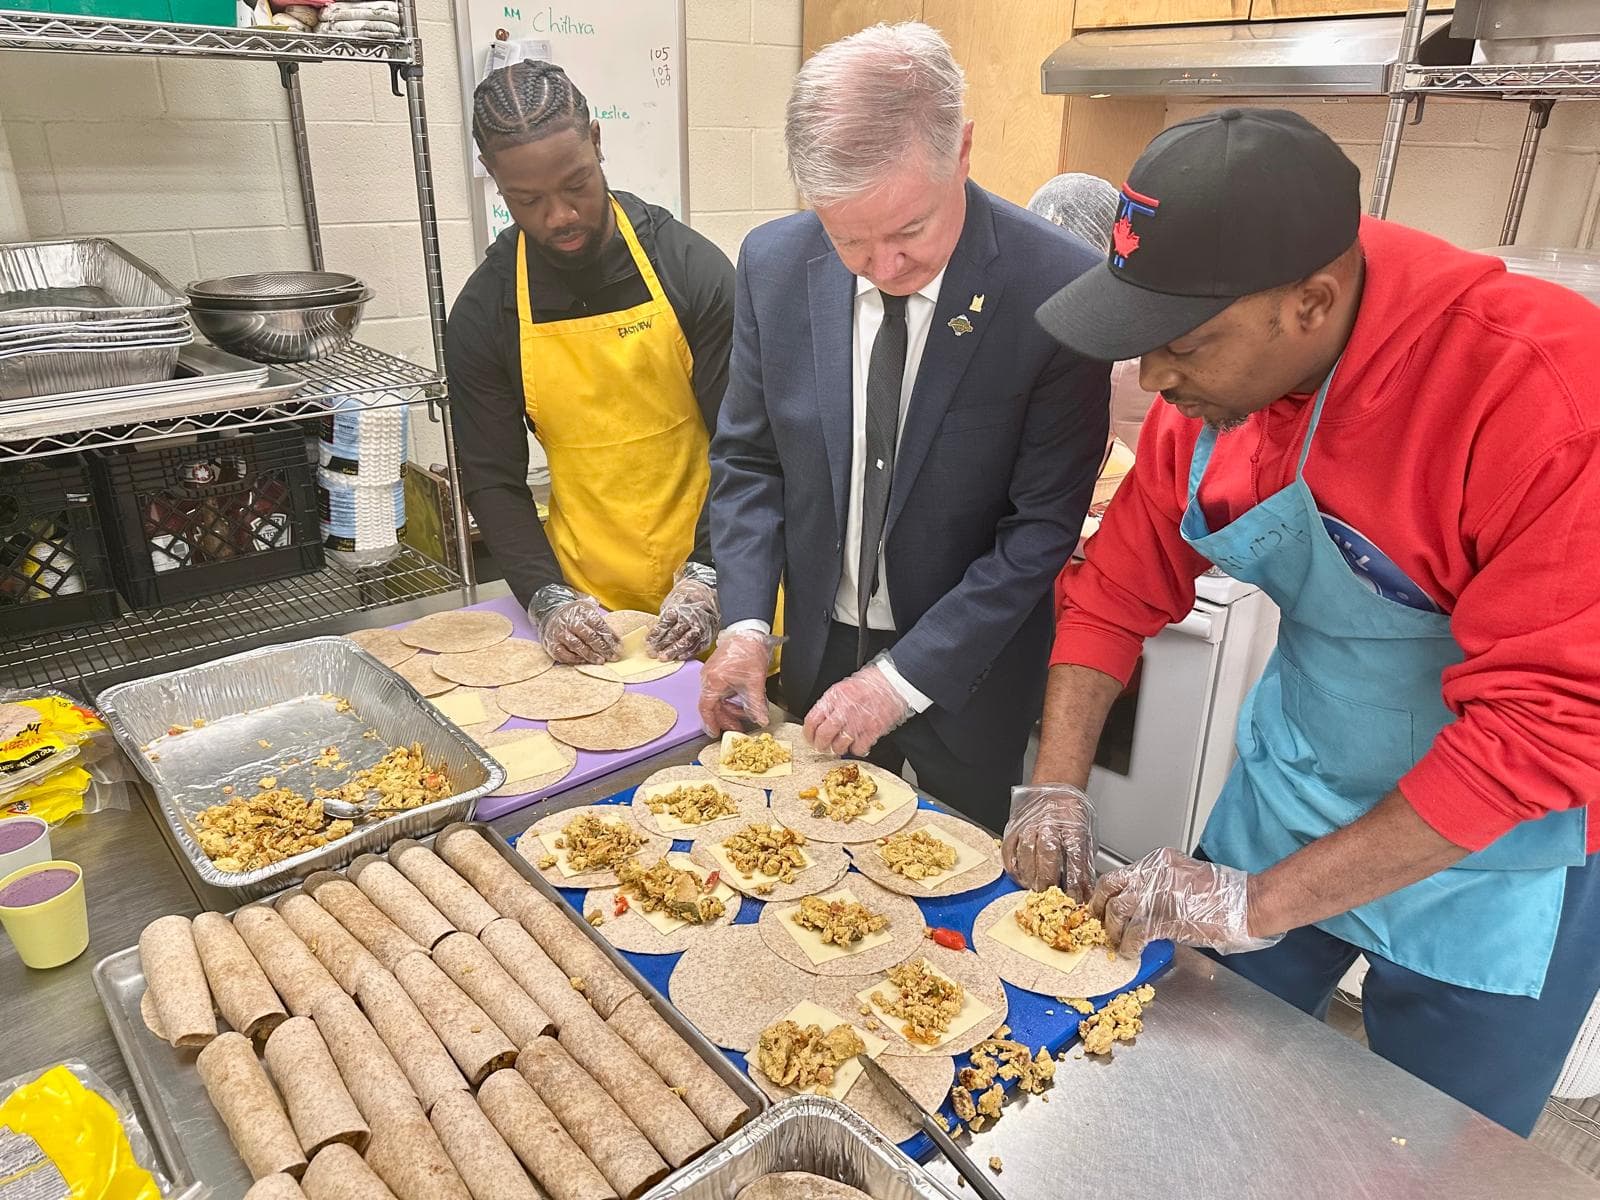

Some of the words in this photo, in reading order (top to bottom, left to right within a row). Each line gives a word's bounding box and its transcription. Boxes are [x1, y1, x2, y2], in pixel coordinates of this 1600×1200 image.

[532, 6, 595, 35] Chithra
[650, 46, 670, 61] 105
[652, 64, 671, 77] 107
[655, 75, 671, 88] 109
[594, 104, 630, 119] Leslie
